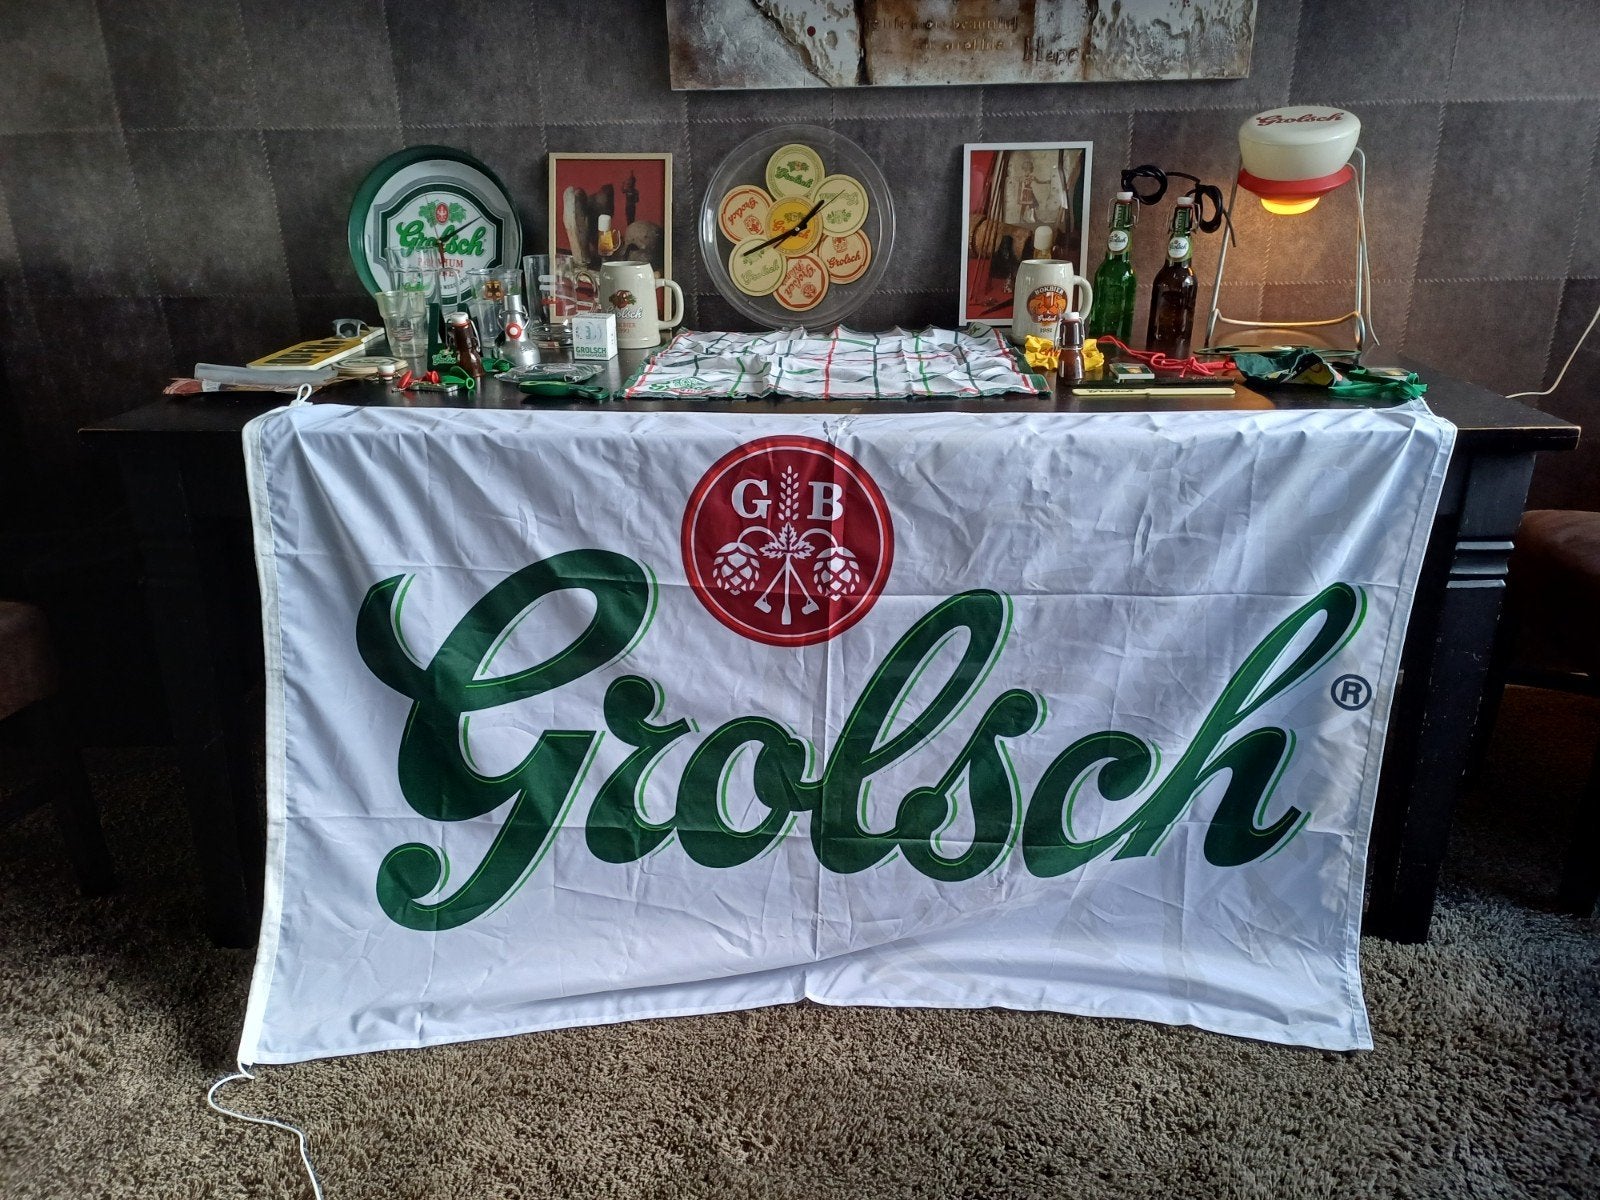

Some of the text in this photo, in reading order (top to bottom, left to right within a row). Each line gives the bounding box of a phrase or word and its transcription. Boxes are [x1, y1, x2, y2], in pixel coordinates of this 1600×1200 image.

[1255, 112, 1345, 127] Grolsch
[826, 250, 862, 269] Grolsch
[575, 346, 608, 355] GROLSCH
[731, 478, 844, 521] G B
[356, 548, 1368, 931] Grolsch
